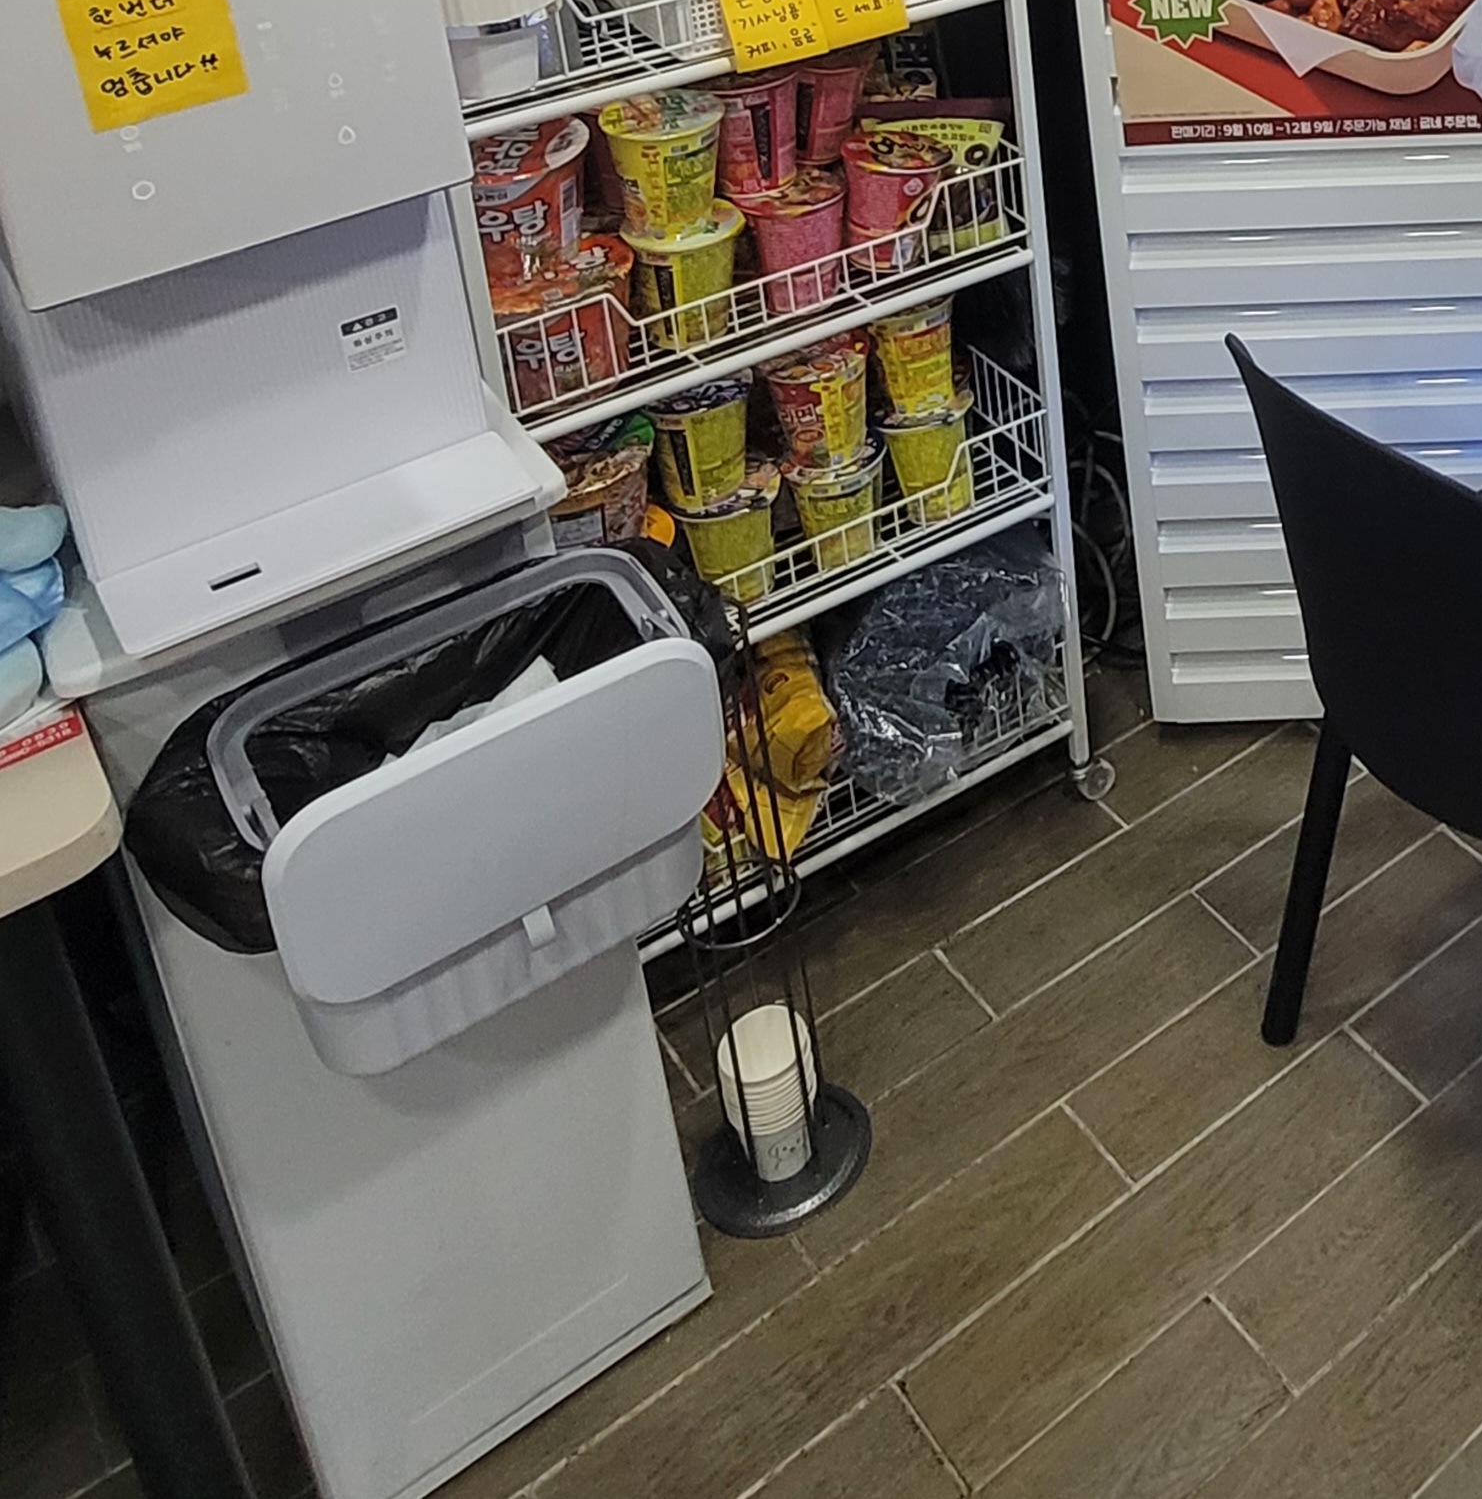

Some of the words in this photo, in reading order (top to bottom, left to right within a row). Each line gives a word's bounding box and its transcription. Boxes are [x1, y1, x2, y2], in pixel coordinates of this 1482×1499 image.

[93, 26, 186, 61] 누르셔야
[1170, 125, 1216, 140] 판매기간
[1223, 123, 1244, 137] 9월
[1246, 122, 1274, 137] 10일
[1313, 119, 1334, 134] 9일
